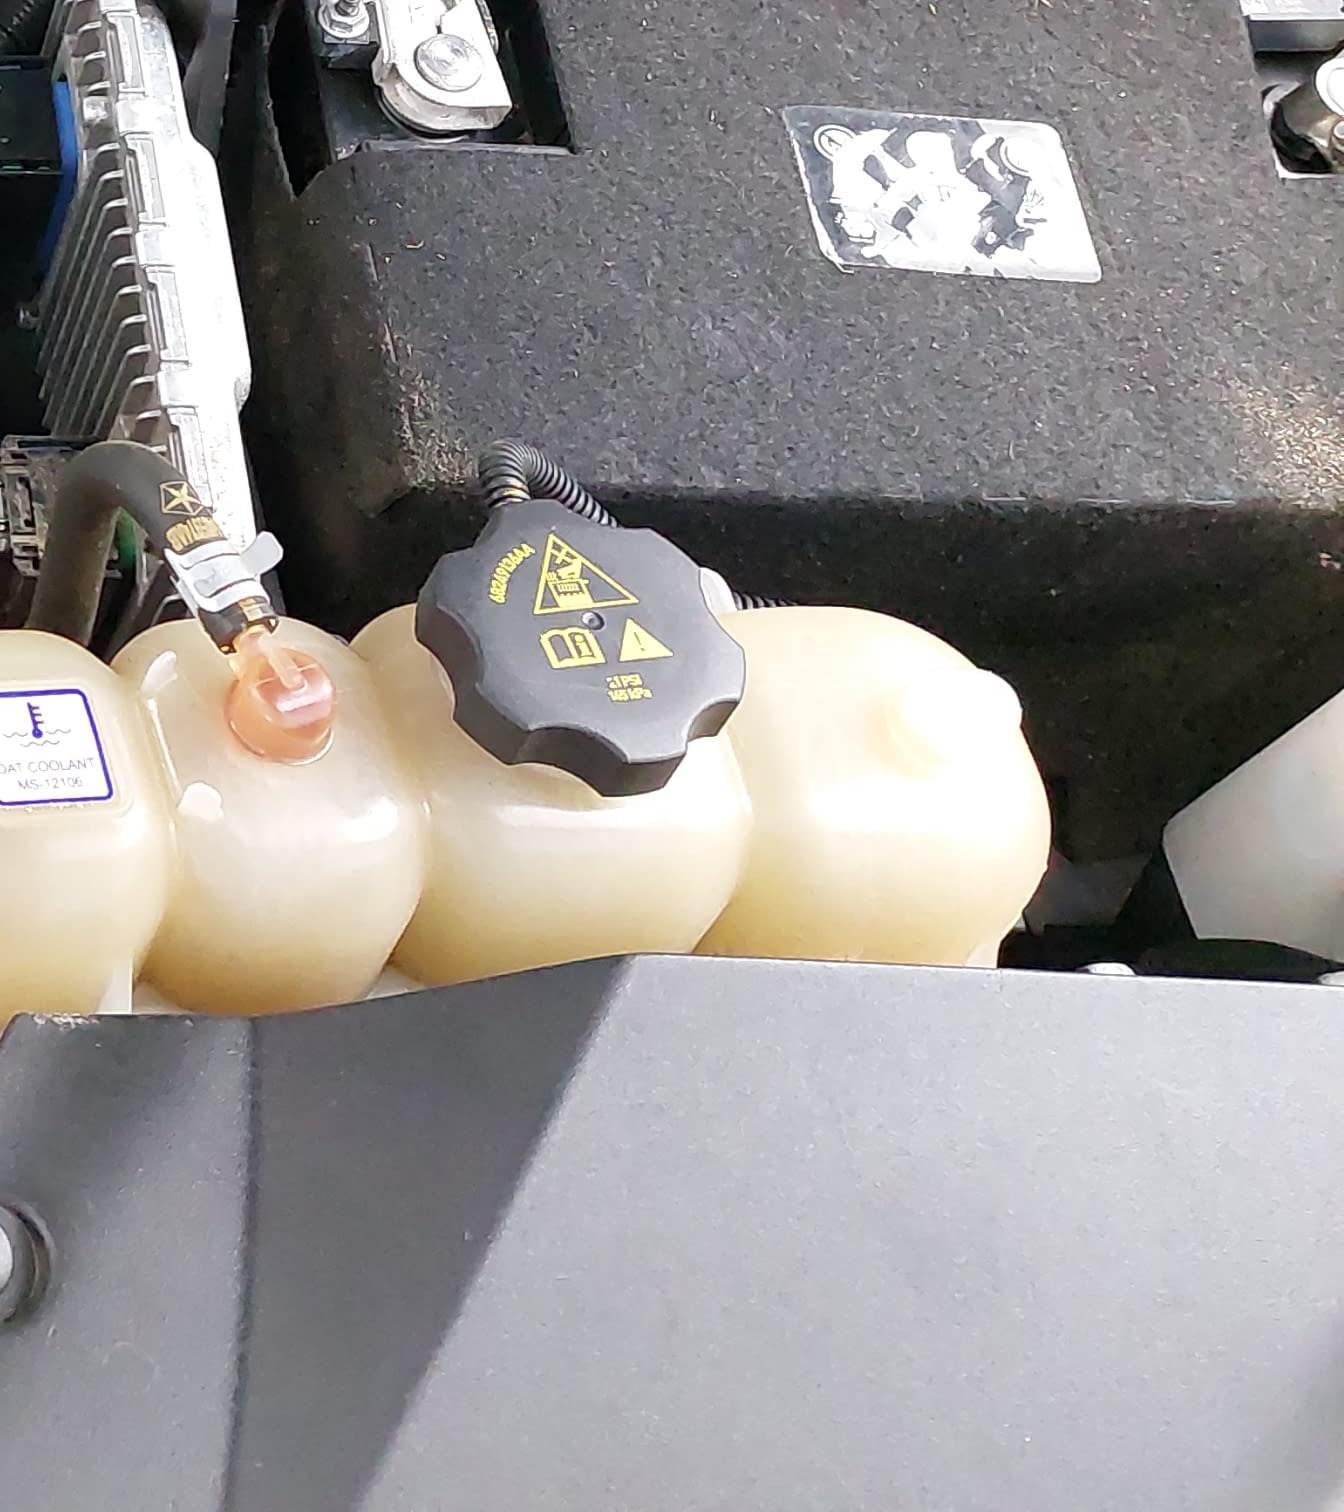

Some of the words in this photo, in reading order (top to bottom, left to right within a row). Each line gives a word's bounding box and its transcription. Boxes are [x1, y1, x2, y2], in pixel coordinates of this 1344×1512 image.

[620, 672, 643, 689] PSI
[626, 685, 653, 701] kPa
[27, 756, 96, 774] COOLANT
